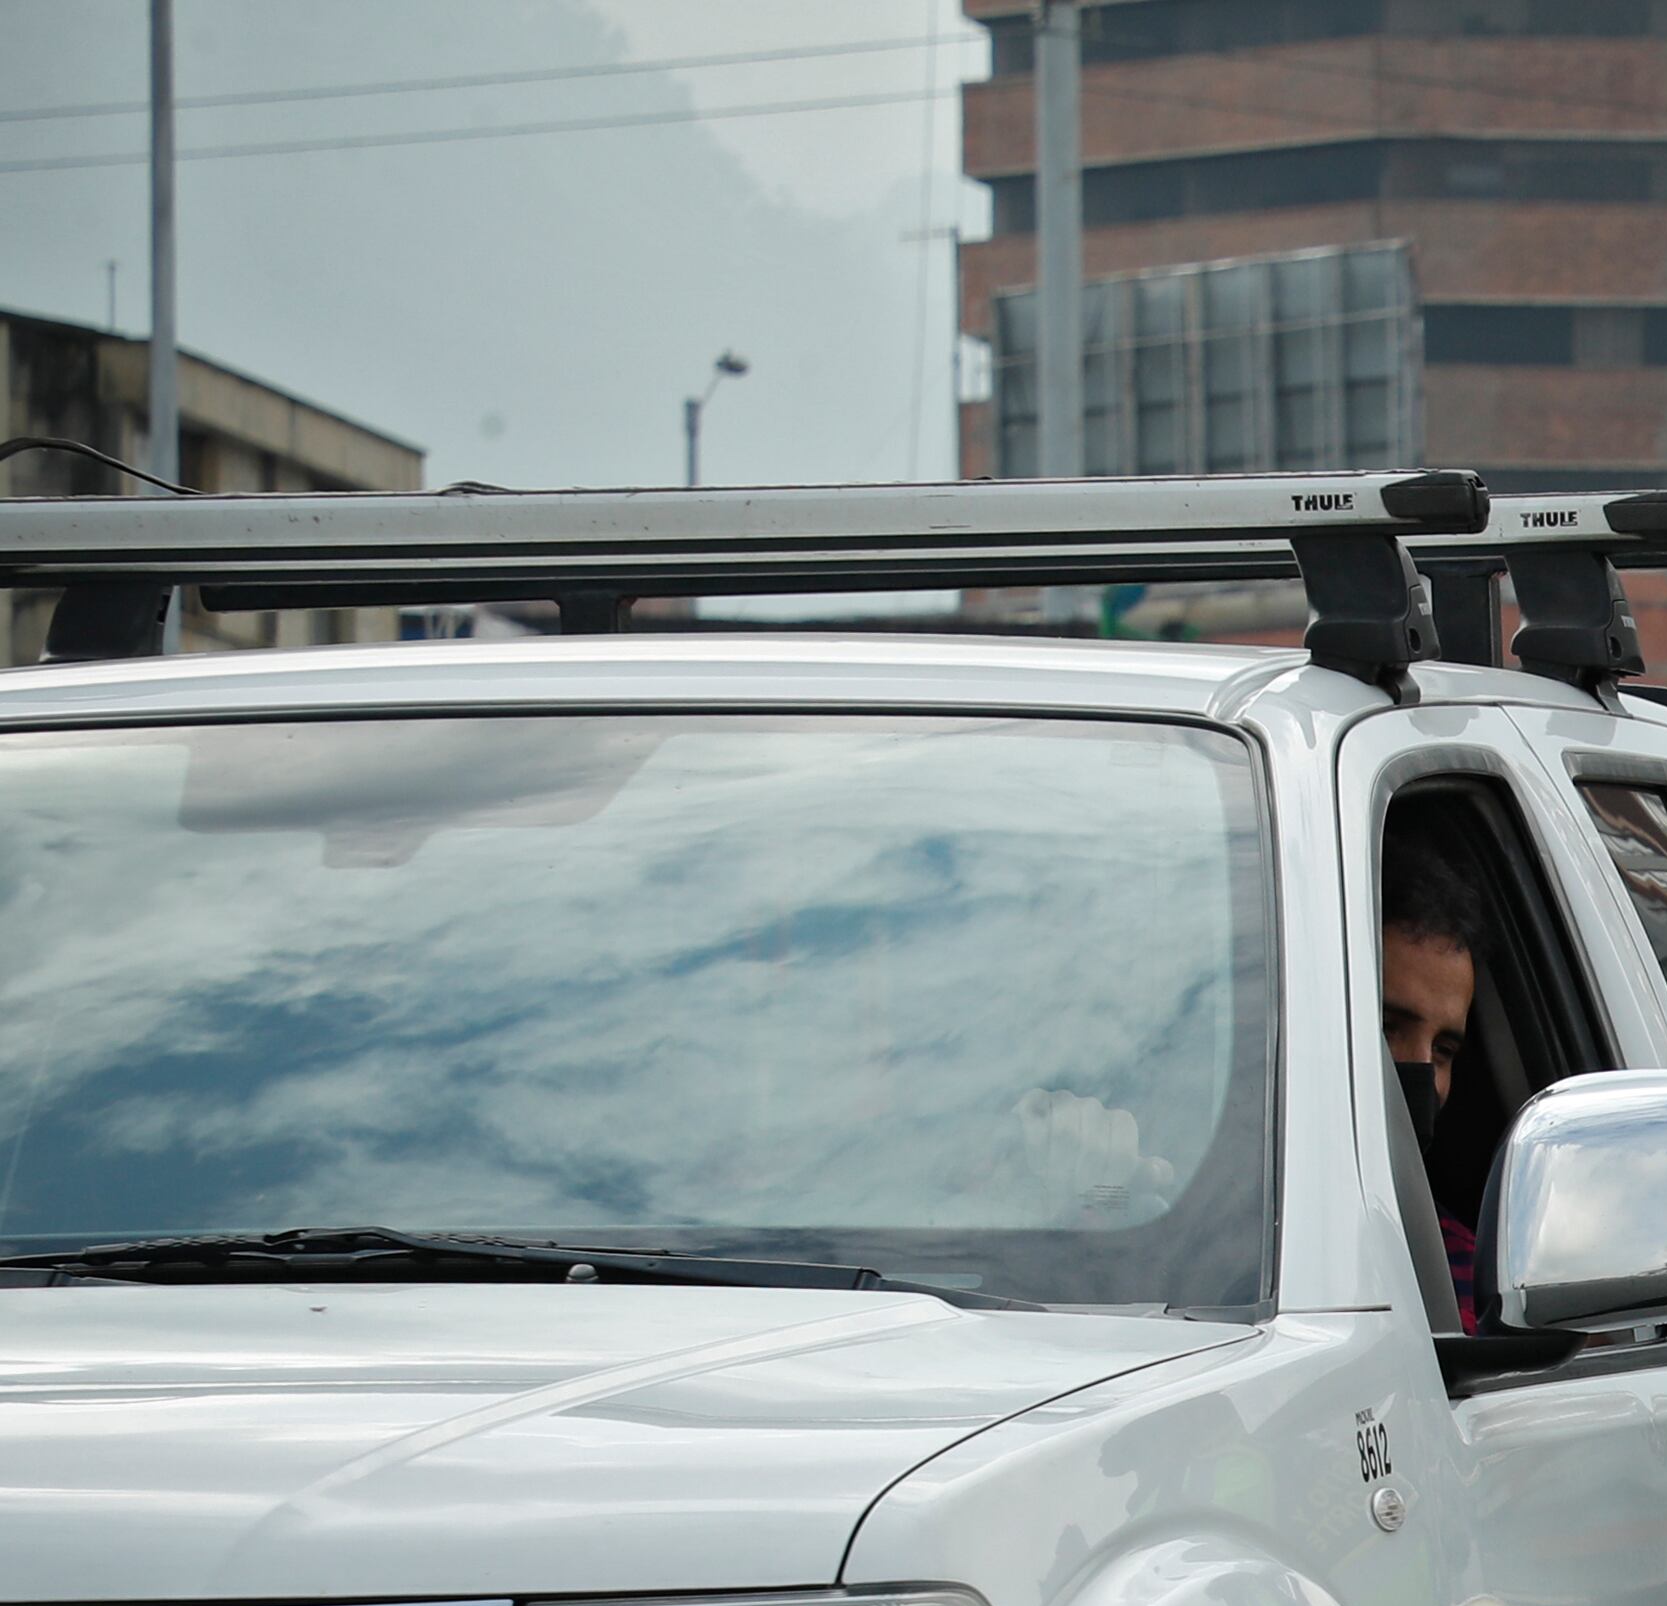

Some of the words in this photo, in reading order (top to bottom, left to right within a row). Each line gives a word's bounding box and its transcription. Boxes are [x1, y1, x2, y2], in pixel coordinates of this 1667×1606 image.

[1291, 494, 1353, 511] THULE
[1520, 511, 1578, 527] THULE
[1357, 1422, 1392, 1483] 8612
